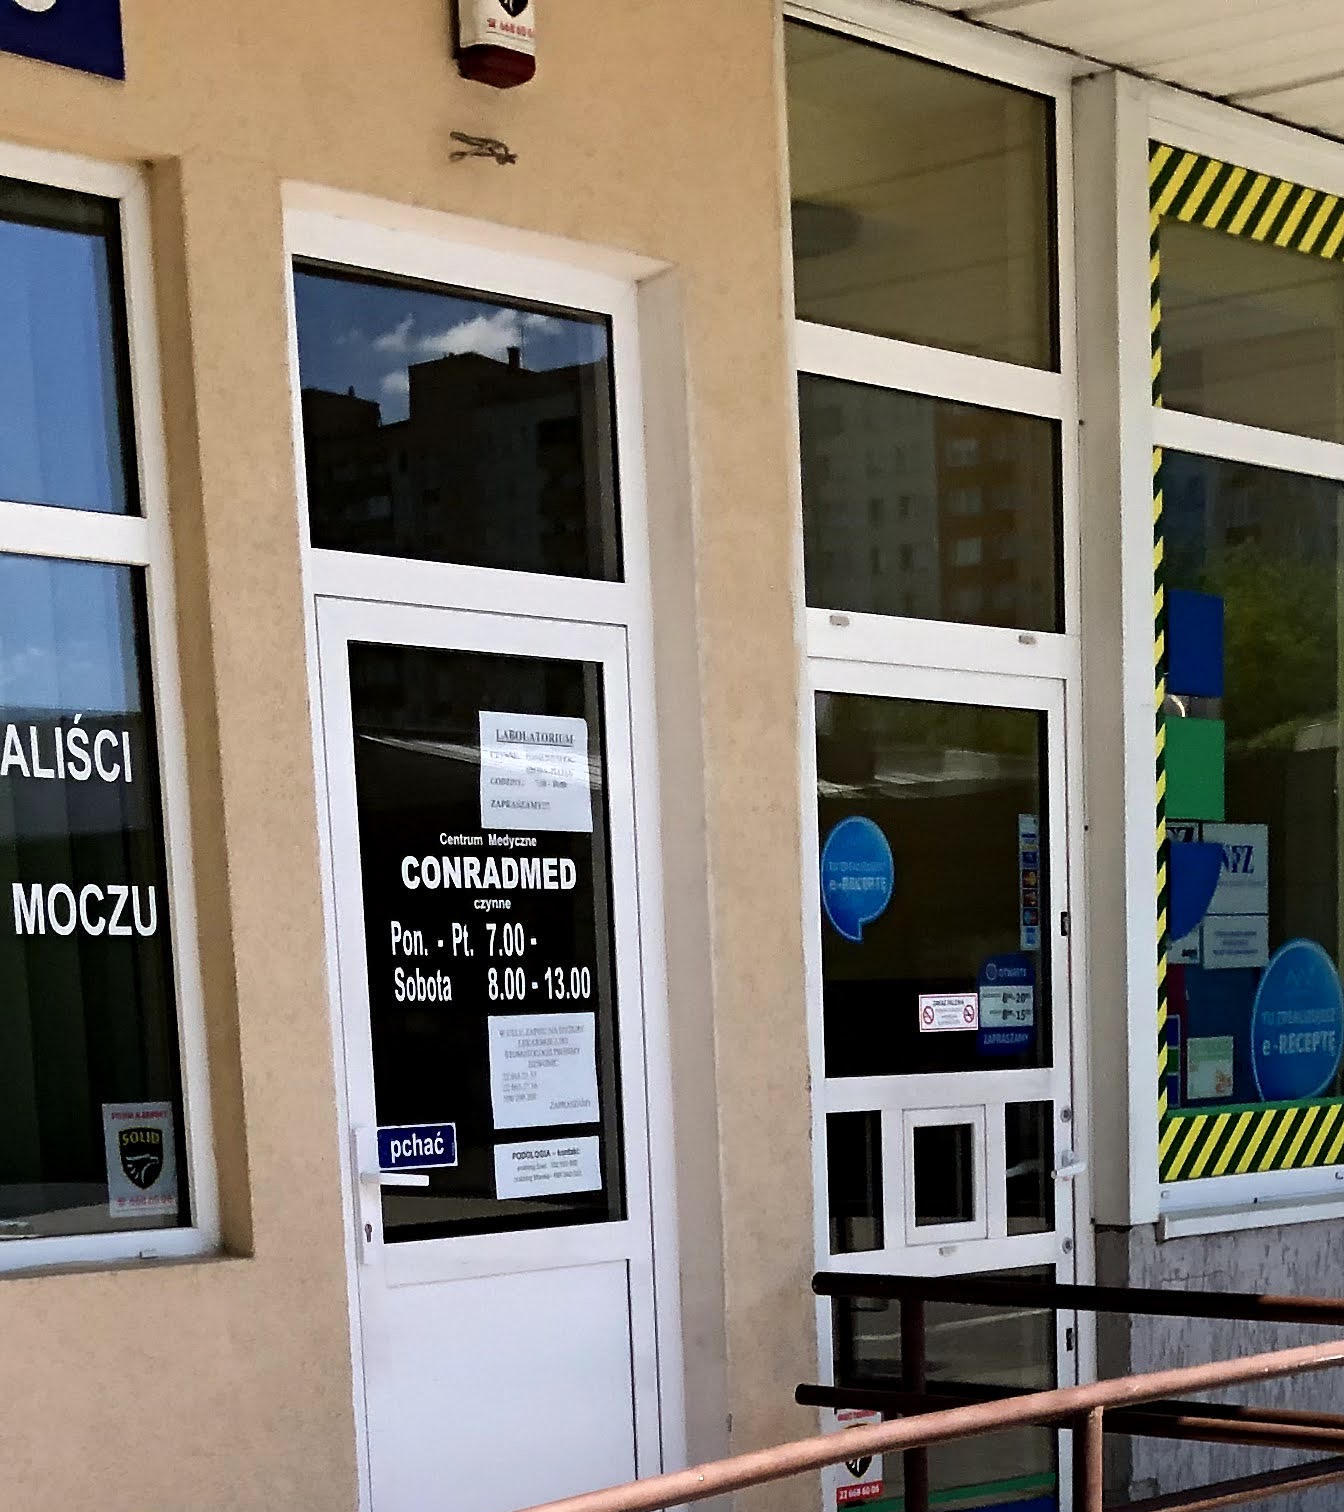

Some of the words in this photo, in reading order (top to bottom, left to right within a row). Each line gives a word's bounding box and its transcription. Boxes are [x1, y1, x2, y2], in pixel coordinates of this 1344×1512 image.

[439, 832, 484, 846] Centrum
[488, 833, 537, 849] Medyczne
[401, 855, 577, 890] CONRADMED
[13, 883, 158, 938] MOCZU
[473, 898, 511, 912] czynne
[390, 920, 428, 956] Pon.
[451, 922, 474, 957] Pt.
[485, 922, 525, 957] 7.00
[394, 966, 452, 1002] Sobota
[487, 966, 526, 1001] 8.00
[544, 966, 591, 1000] 13.00
[121, 1131, 160, 1146] SOLID
[390, 1130, 445, 1164] pchać
